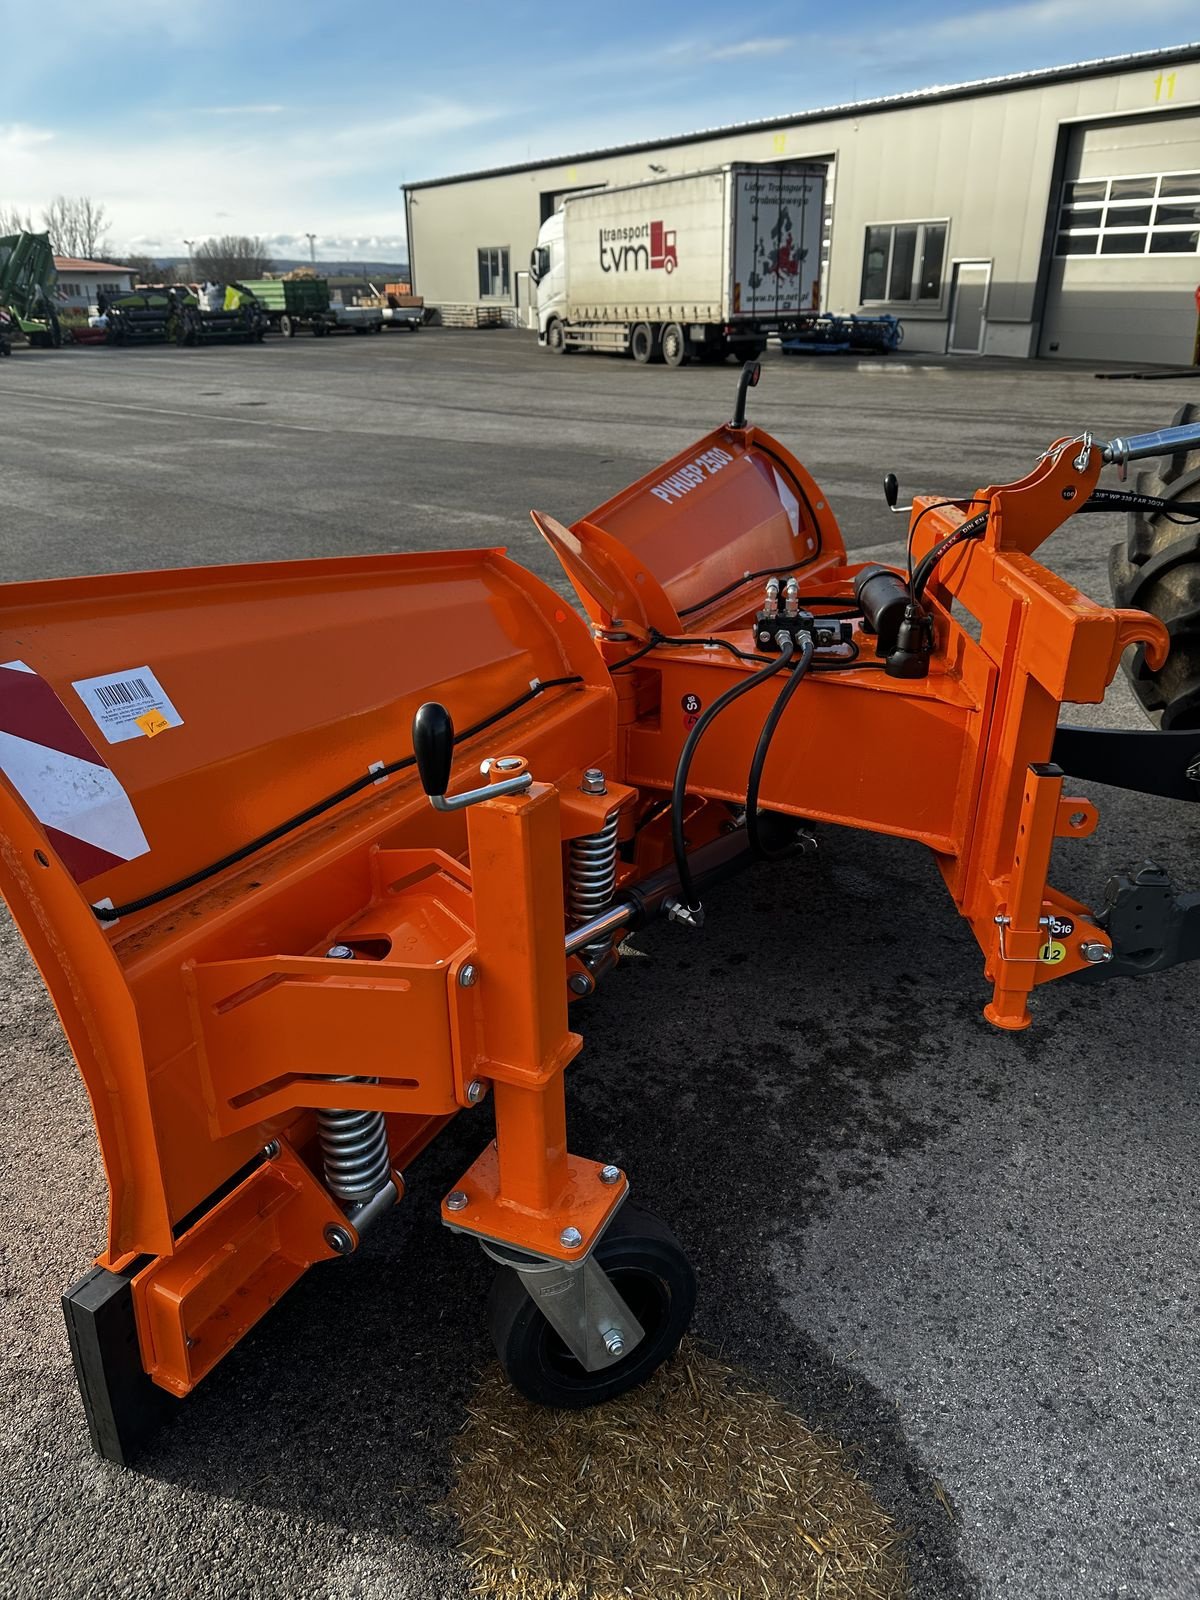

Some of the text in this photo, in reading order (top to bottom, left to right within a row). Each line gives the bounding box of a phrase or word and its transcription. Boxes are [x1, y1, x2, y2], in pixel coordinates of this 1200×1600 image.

[1153, 70, 1178, 101] 11
[603, 224, 649, 242] transport
[599, 228, 649, 273] tvm
[746, 292, 810, 302] www.tvm.netpl
[650, 447, 734, 505] PVHU5P 2500
[962, 523, 975, 533] DIN
[974, 516, 985, 526] EN
[1052, 921, 1072, 934] S16
[1043, 946, 1061, 960] L2
